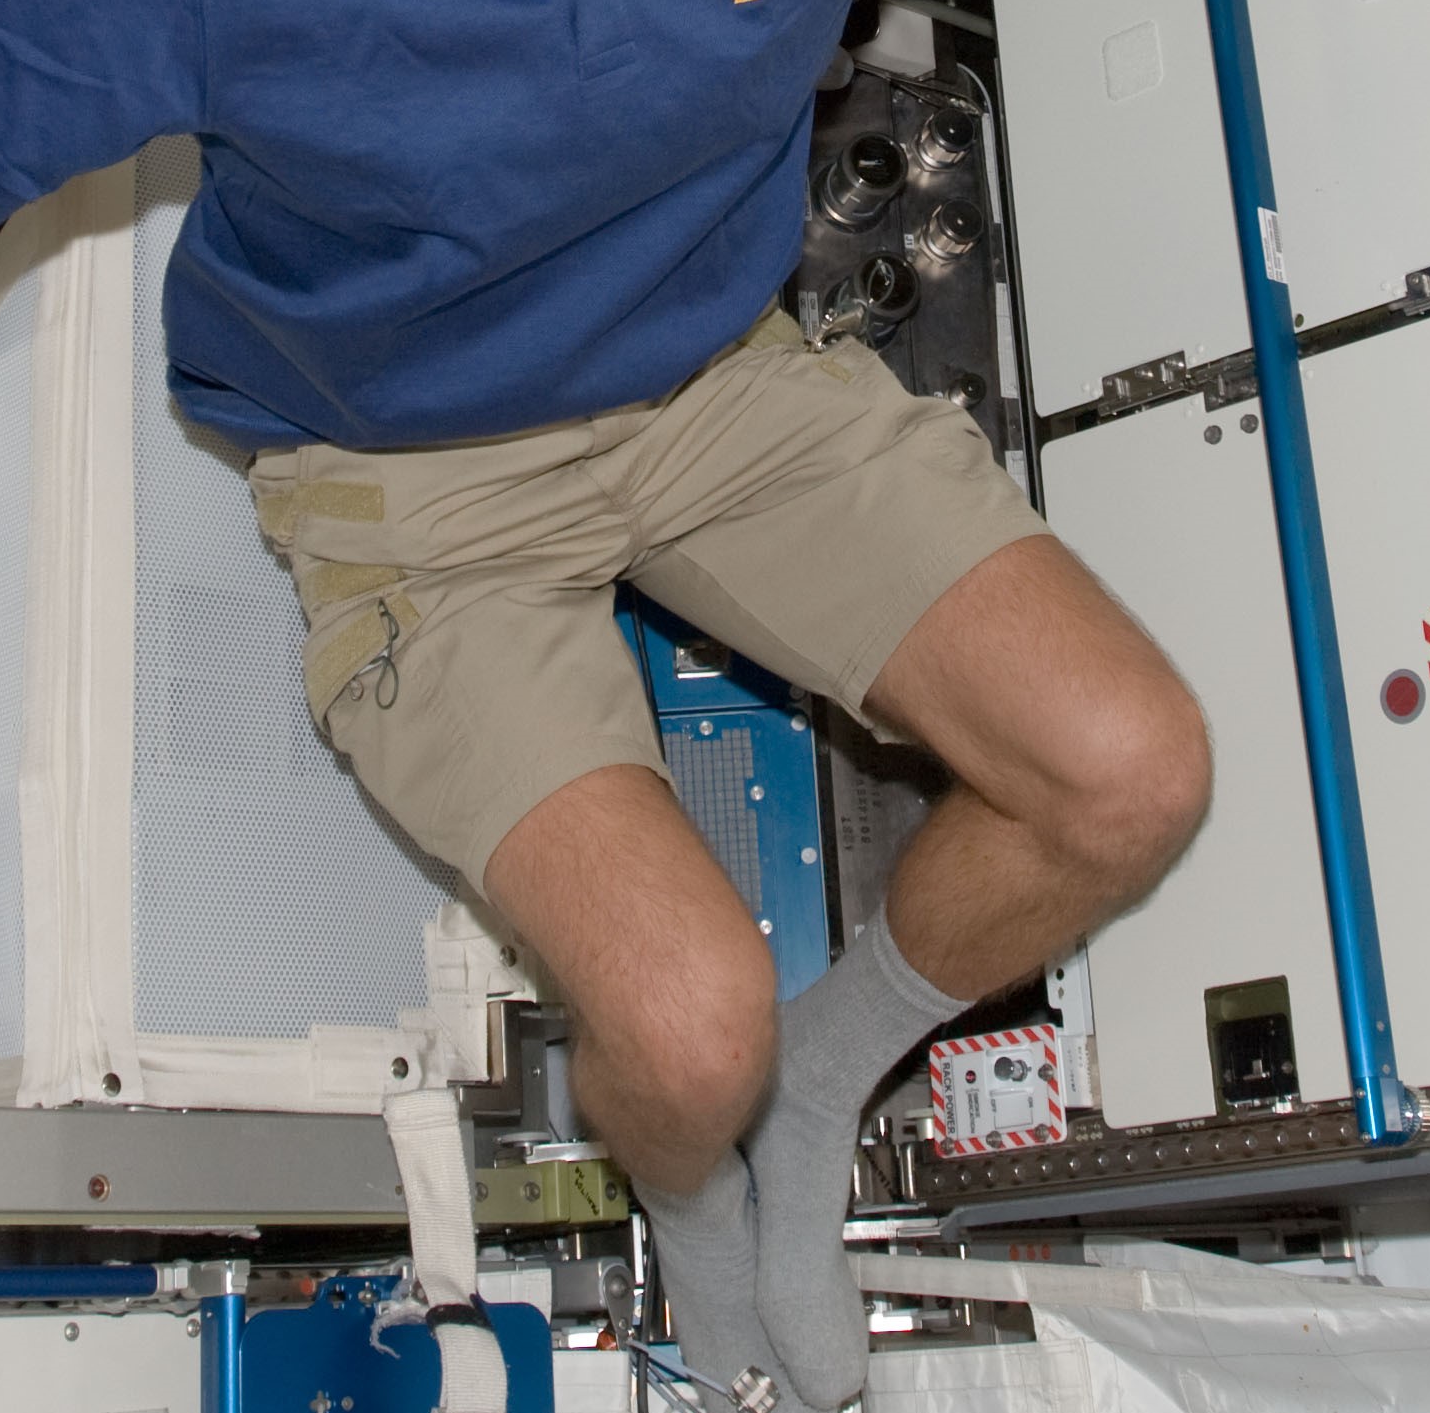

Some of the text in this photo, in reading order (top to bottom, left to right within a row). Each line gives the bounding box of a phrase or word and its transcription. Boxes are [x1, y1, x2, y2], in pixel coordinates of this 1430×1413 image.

[940, 1061, 955, 1134] RACK POWER
[967, 1092, 975, 1134] INDICATION
[972, 1092, 980, 1117] SMOKE
[1027, 1096, 1033, 1108] ON
